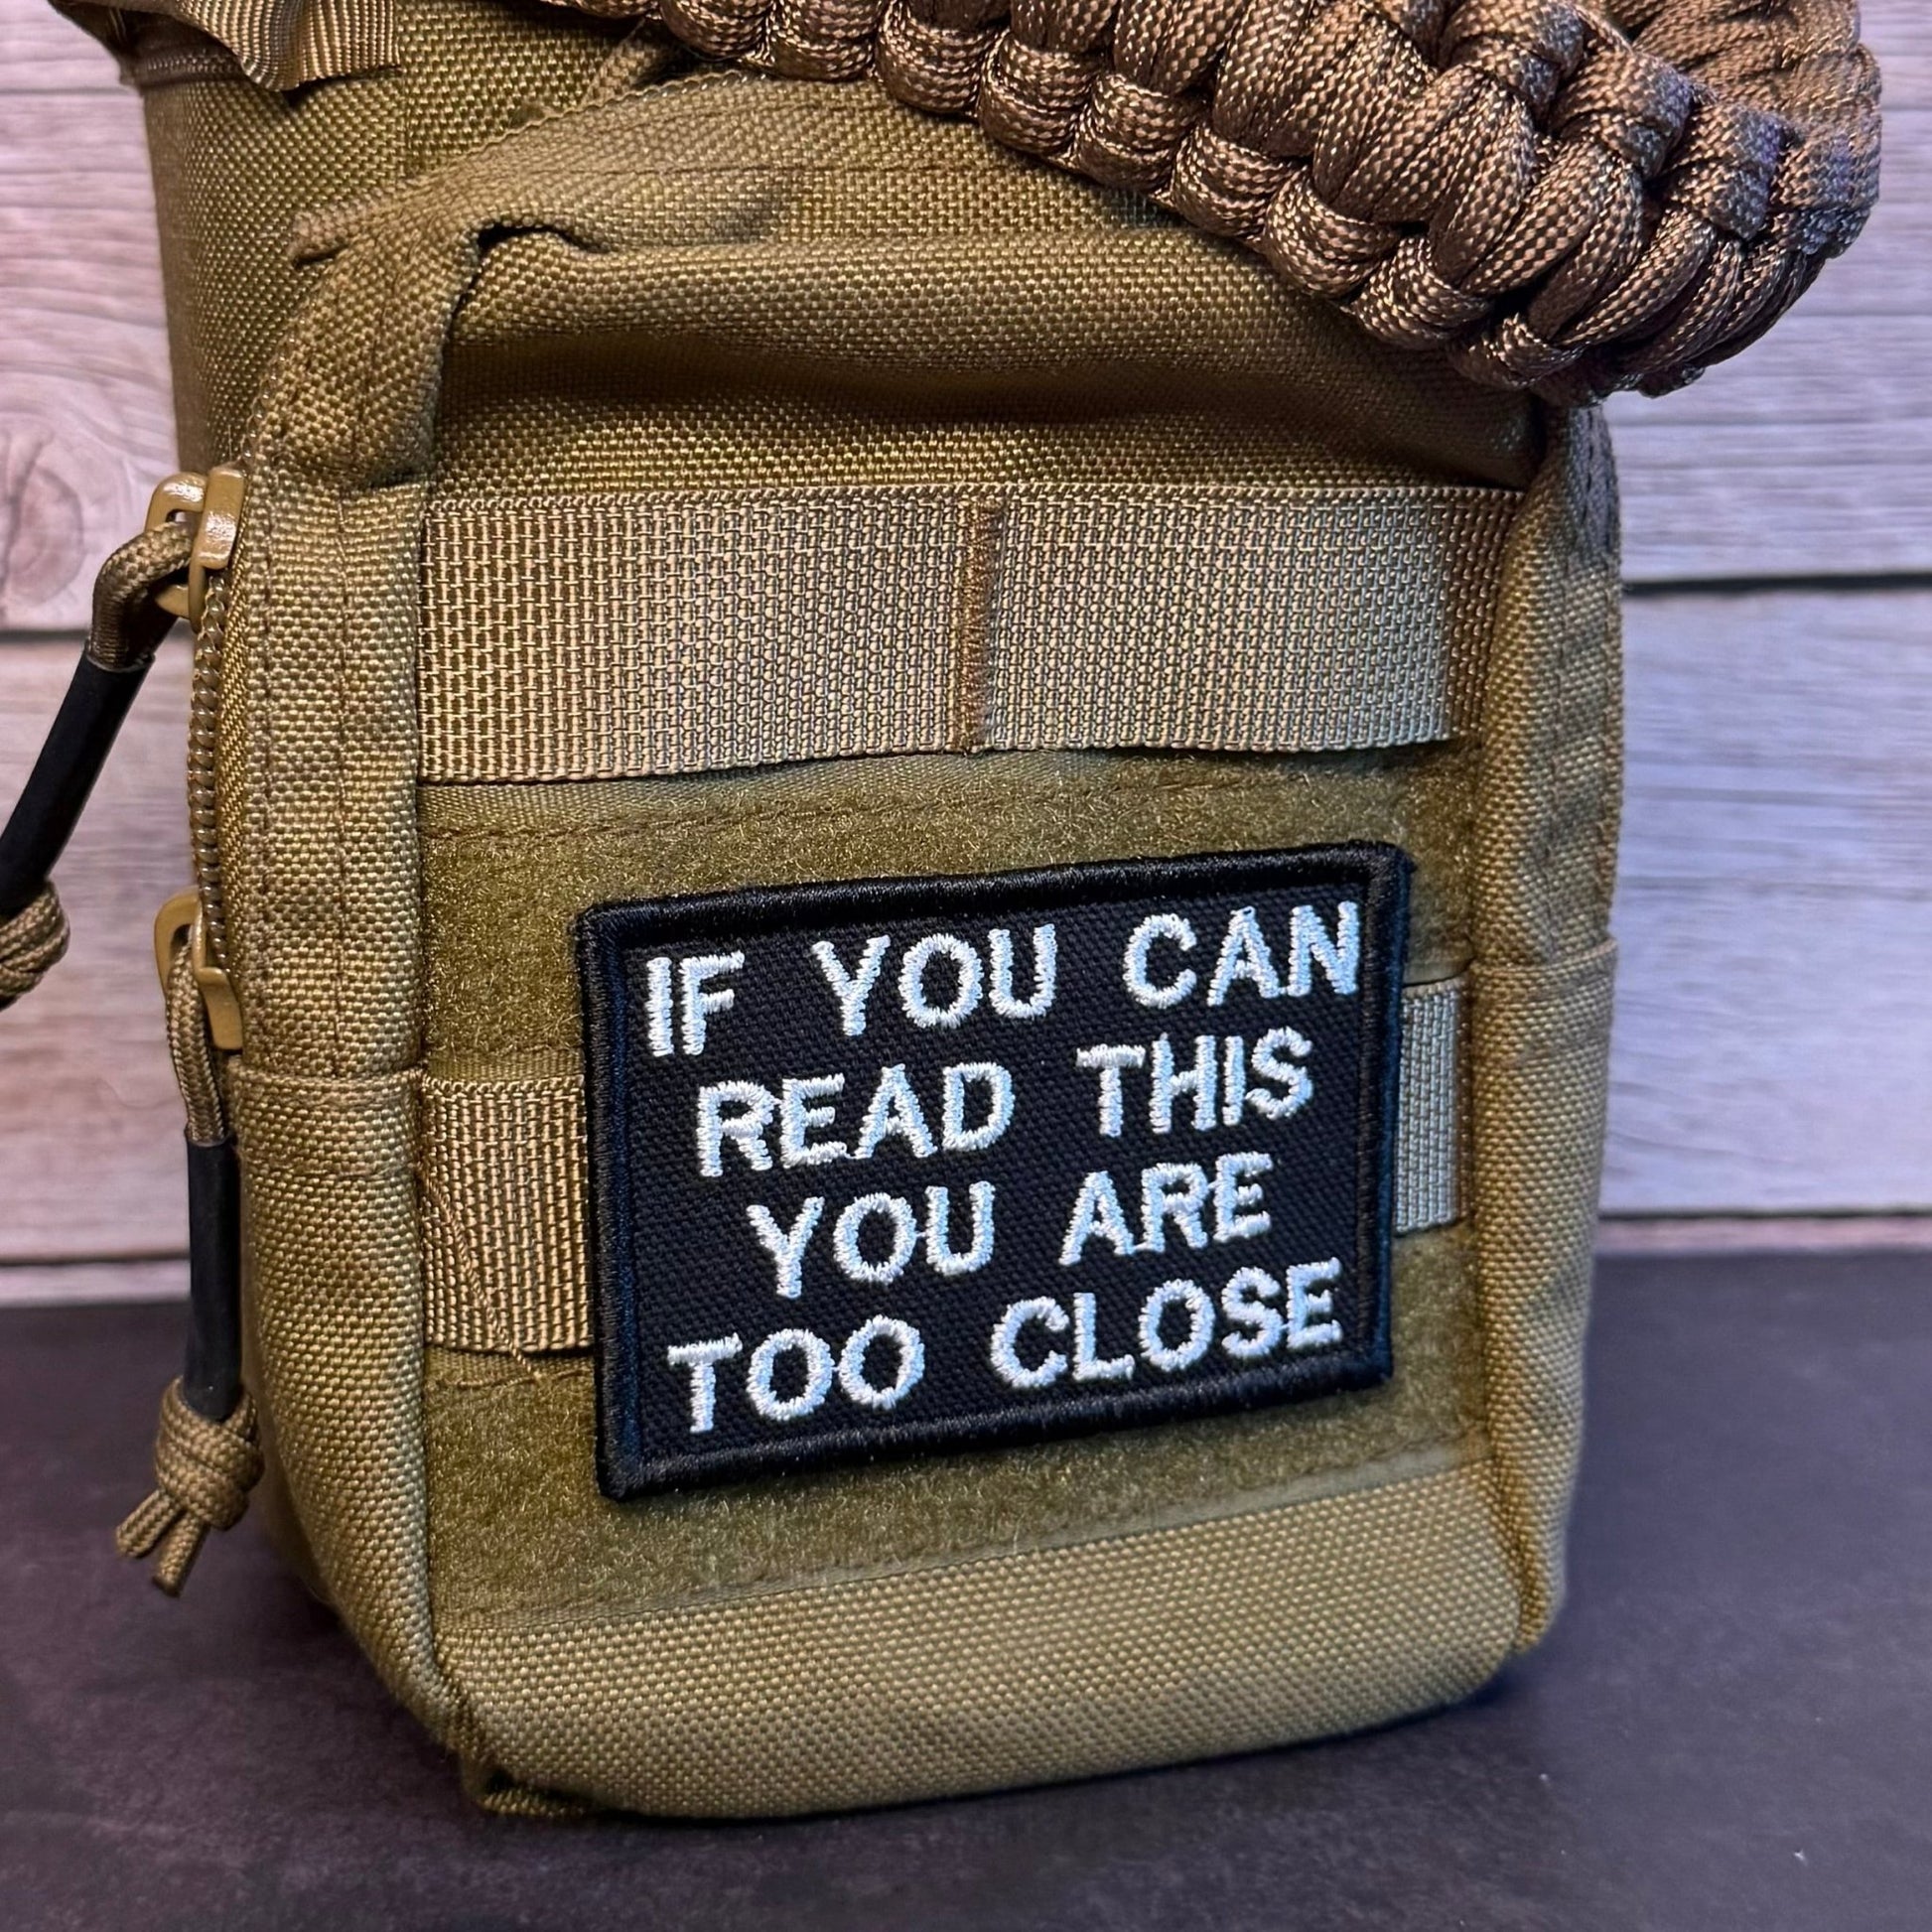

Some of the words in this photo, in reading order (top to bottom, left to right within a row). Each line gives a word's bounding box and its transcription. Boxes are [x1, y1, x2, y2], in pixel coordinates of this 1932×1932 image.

[645, 950, 745, 1057] IF
[811, 924, 1057, 1036] YOU
[1123, 901, 1359, 1009] CAN
[696, 1062, 1016, 1176] READ
[1076, 1027, 1312, 1137] THIS
[747, 1181, 996, 1299] YOU
[1058, 1152, 1273, 1266] ARE
[667, 1314, 924, 1433] TOO
[990, 1258, 1341, 1387] CLOSE
